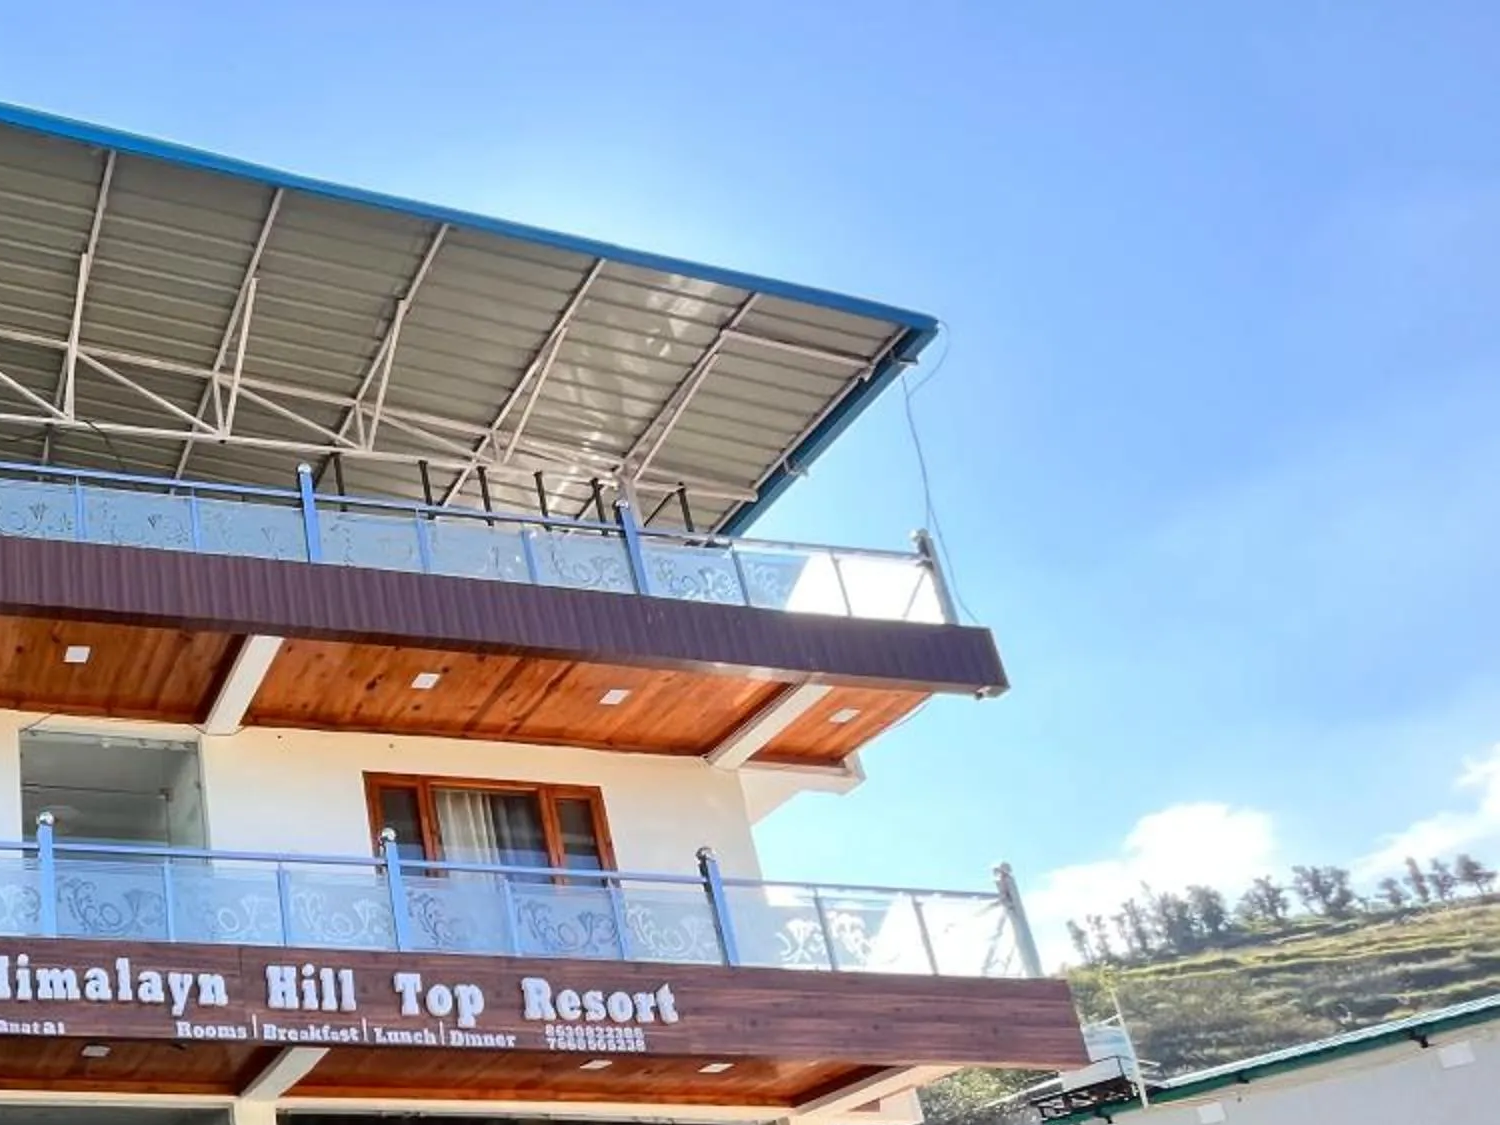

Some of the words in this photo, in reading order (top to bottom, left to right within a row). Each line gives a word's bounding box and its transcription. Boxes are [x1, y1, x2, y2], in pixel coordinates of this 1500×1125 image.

[265, 963, 357, 1011] Hill
[394, 972, 485, 1028] Top
[521, 977, 679, 1023] Resort
[176, 1021, 247, 1039] Rooms
[263, 1023, 359, 1042] Breakfast
[374, 1027, 436, 1045] Lunch
[451, 1030, 517, 1047] Dinner
